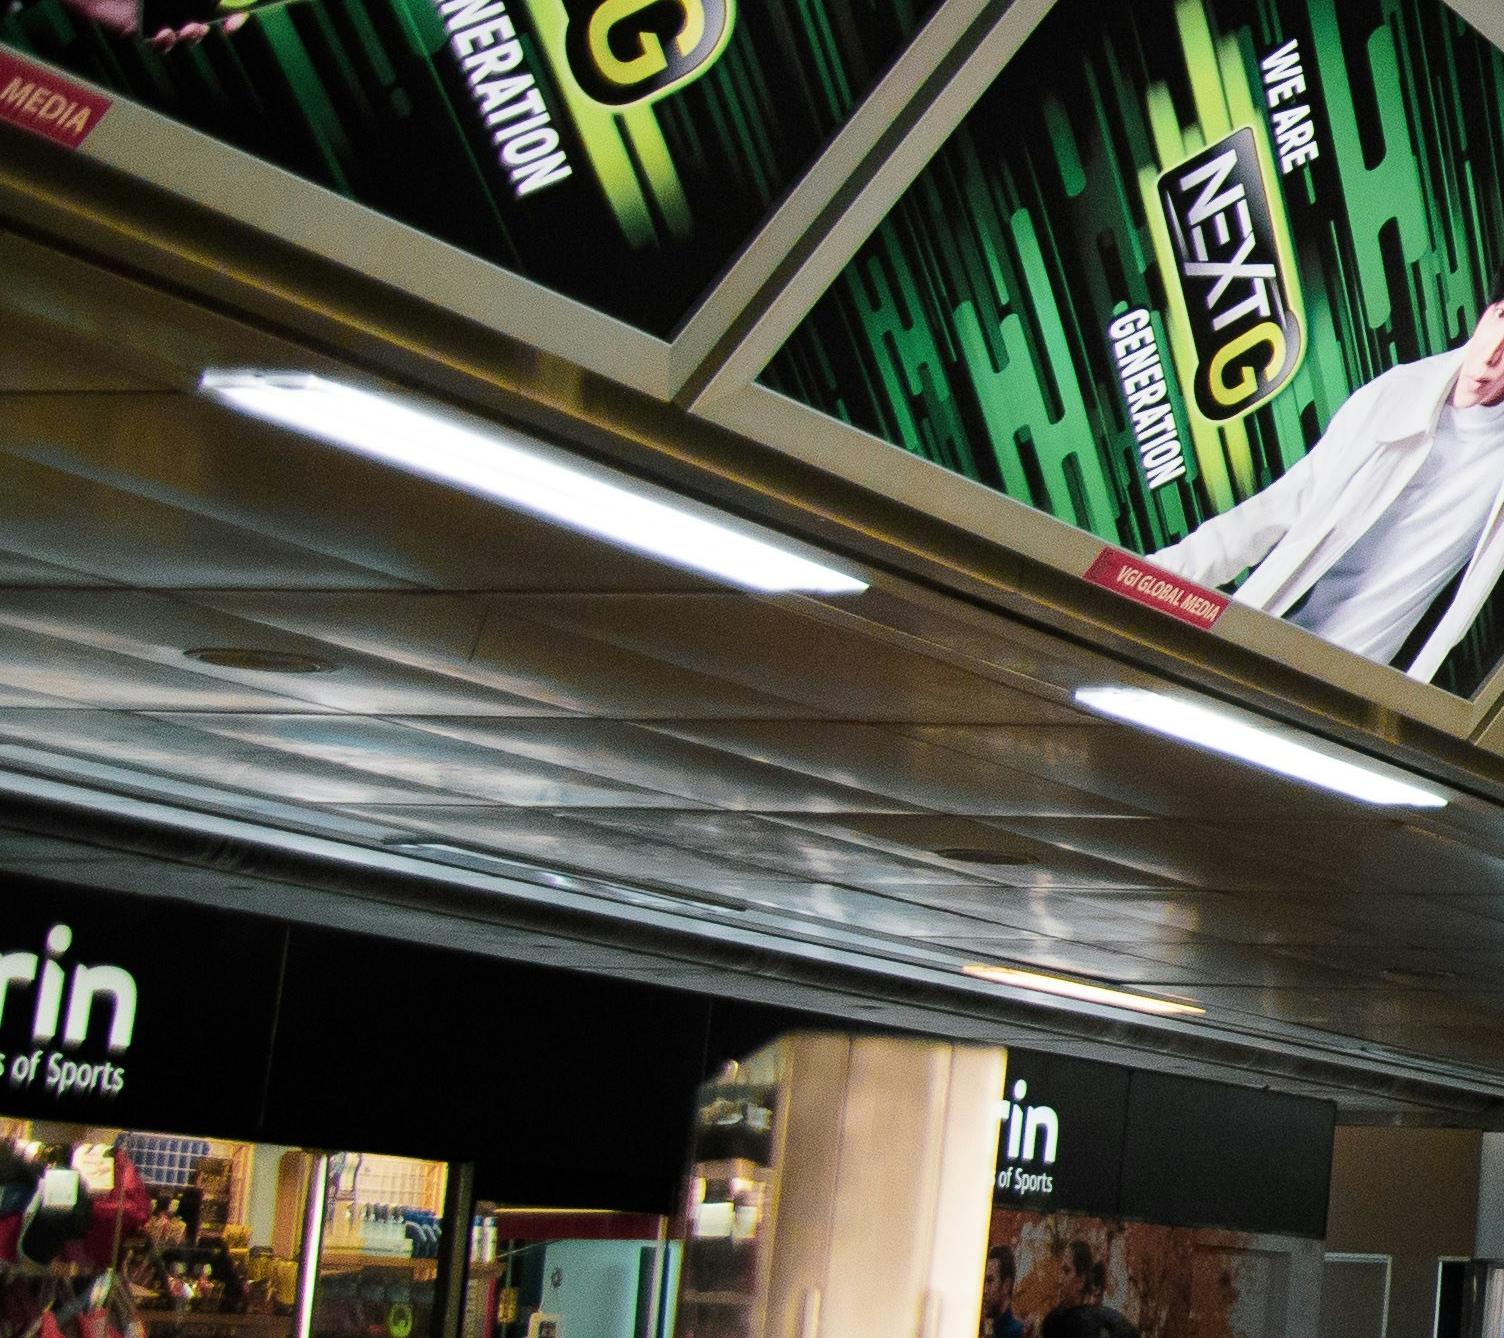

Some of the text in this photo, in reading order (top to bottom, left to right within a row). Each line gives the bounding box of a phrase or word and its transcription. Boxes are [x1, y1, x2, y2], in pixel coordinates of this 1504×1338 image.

[0, 76, 92, 137] MEDIA
[1259, 37, 1322, 175] WE ARE
[1108, 304, 1192, 492] GENERATION
[1117, 565, 1221, 622] VGI GLOBAL MEDIA
[12, 1049, 126, 1095] of Sports
[998, 1166, 1053, 1195] of Sports
